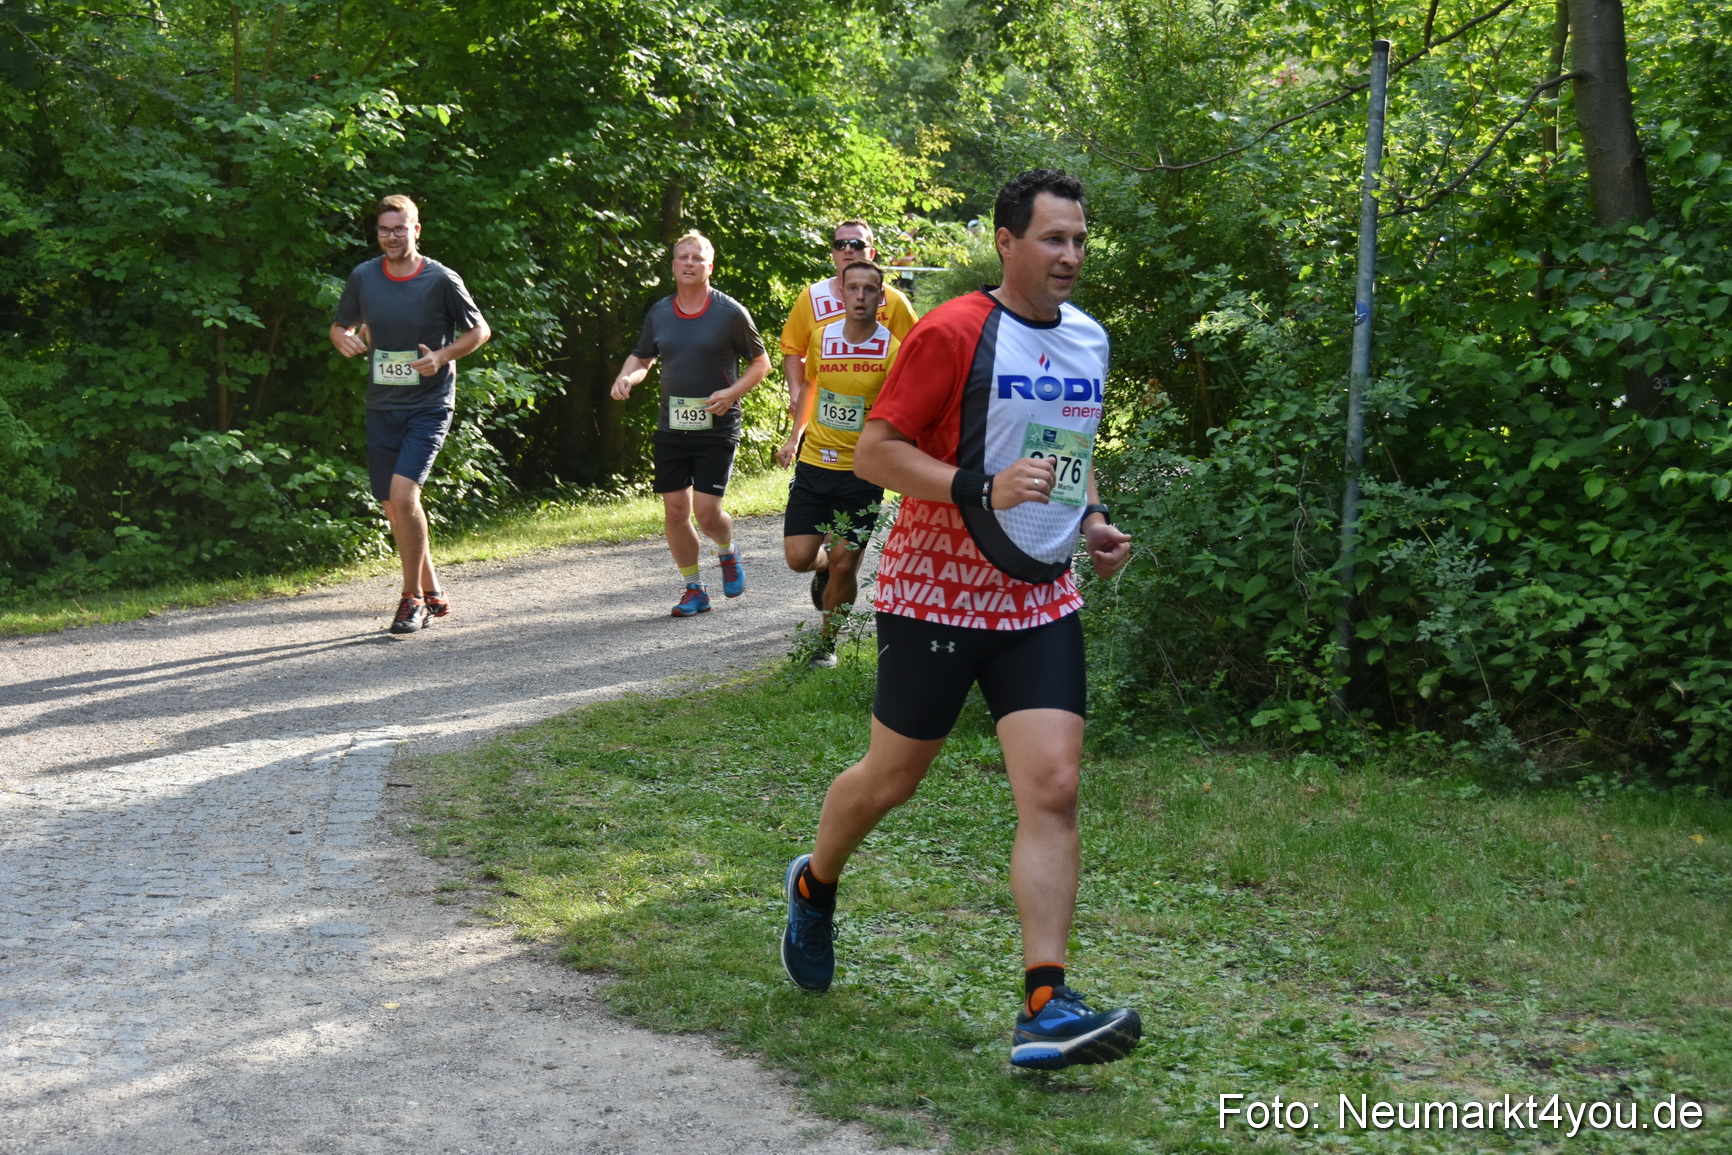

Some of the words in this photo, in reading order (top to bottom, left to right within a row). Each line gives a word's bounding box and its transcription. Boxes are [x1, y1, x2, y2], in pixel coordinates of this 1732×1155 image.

[379, 363, 412, 376] 1483
[820, 363, 848, 373] MAX
[853, 361, 886, 373] BÖGL
[674, 409, 706, 421] 1493
[823, 403, 857, 422] 1632
[937, 561, 1004, 587] AVIA
[951, 587, 1017, 612] AVIA
[924, 611, 988, 630] AVIA
[995, 609, 1054, 631] AVIA
